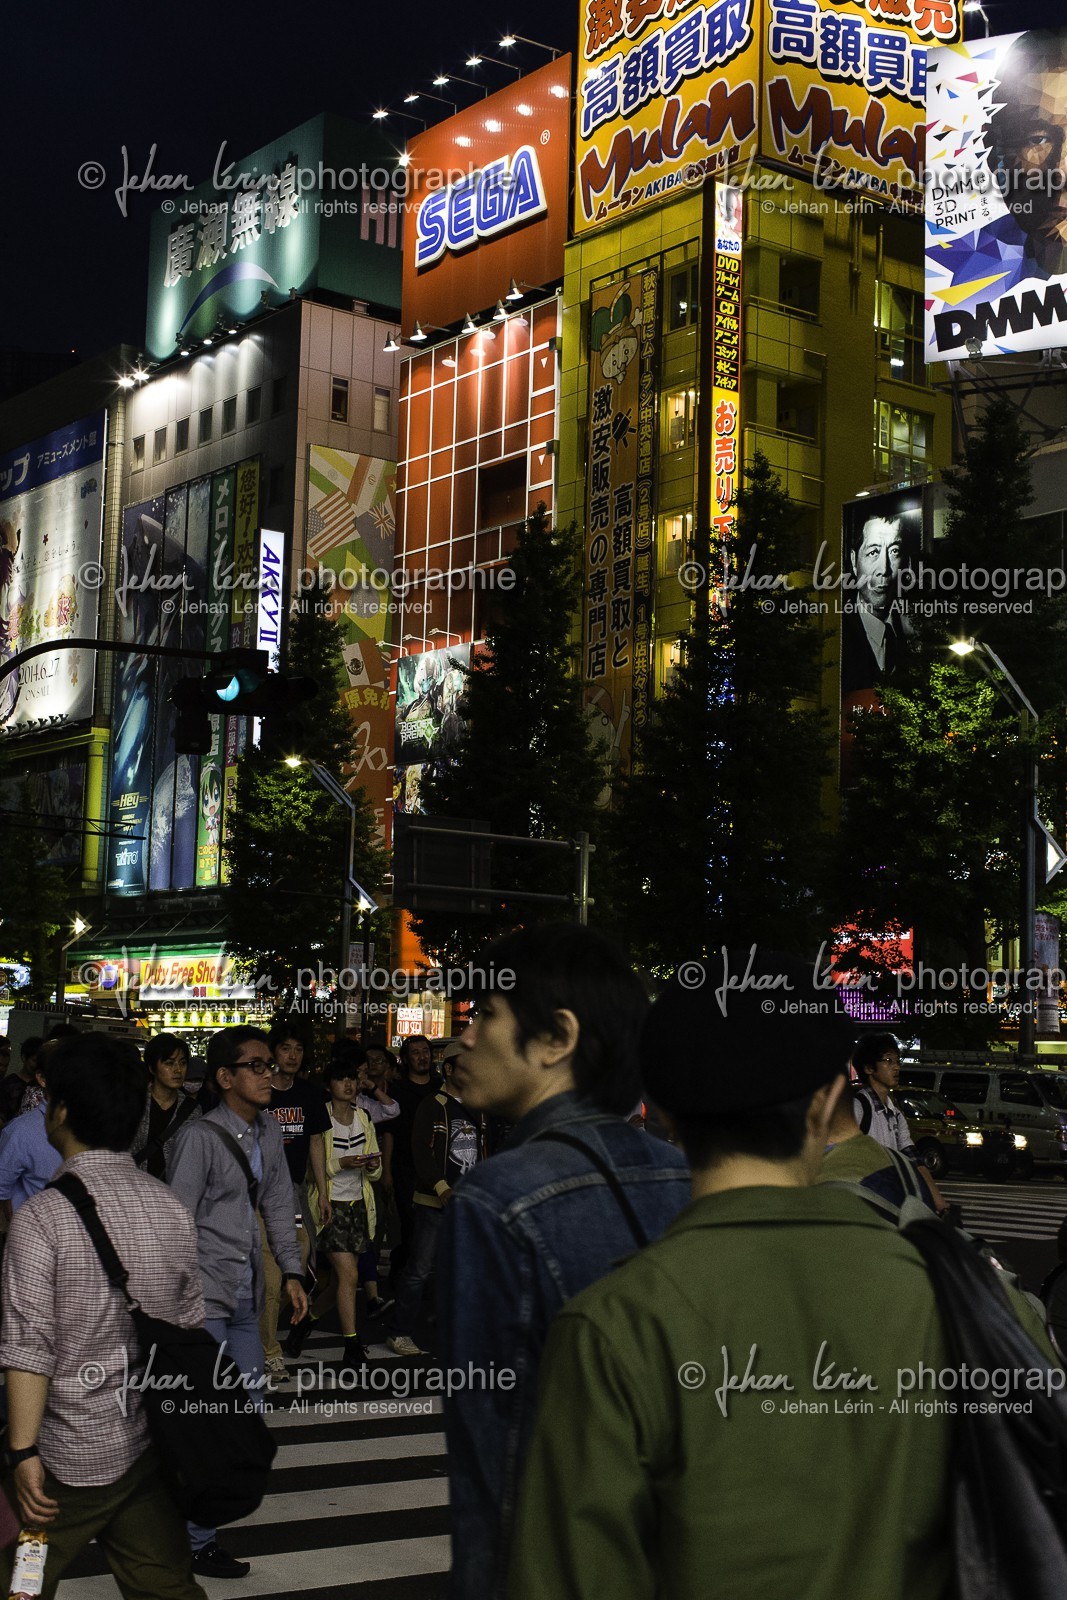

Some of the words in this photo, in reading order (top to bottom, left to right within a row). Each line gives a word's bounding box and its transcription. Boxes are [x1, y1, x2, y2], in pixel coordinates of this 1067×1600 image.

[584, 0, 747, 133] 高額買取
[580, 80, 756, 219] Mulan
[645, 170, 682, 200] AKIBA
[931, 178, 974, 201] DMM
[415, 145, 547, 268] SEGA
[934, 199, 957, 216] 3D
[935, 208, 977, 229] PRINT
[717, 239, 740, 252] あなたの
[717, 256, 739, 272] DVD
[716, 285, 739, 302] ゲーム
[720, 301, 735, 315] CD
[715, 329, 738, 345] アニメ
[715, 345, 737, 360] コミック
[585, 383, 613, 680] 激安販売の専門店
[257, 542, 280, 627] AKKY
[609, 481, 635, 669] 高額買取と
[399, 717, 434, 733] BORDER
[400, 729, 428, 747] BREAK
[119, 792, 140, 808] Hey
[144, 963, 168, 986] Duty
[171, 961, 195, 984] Free
